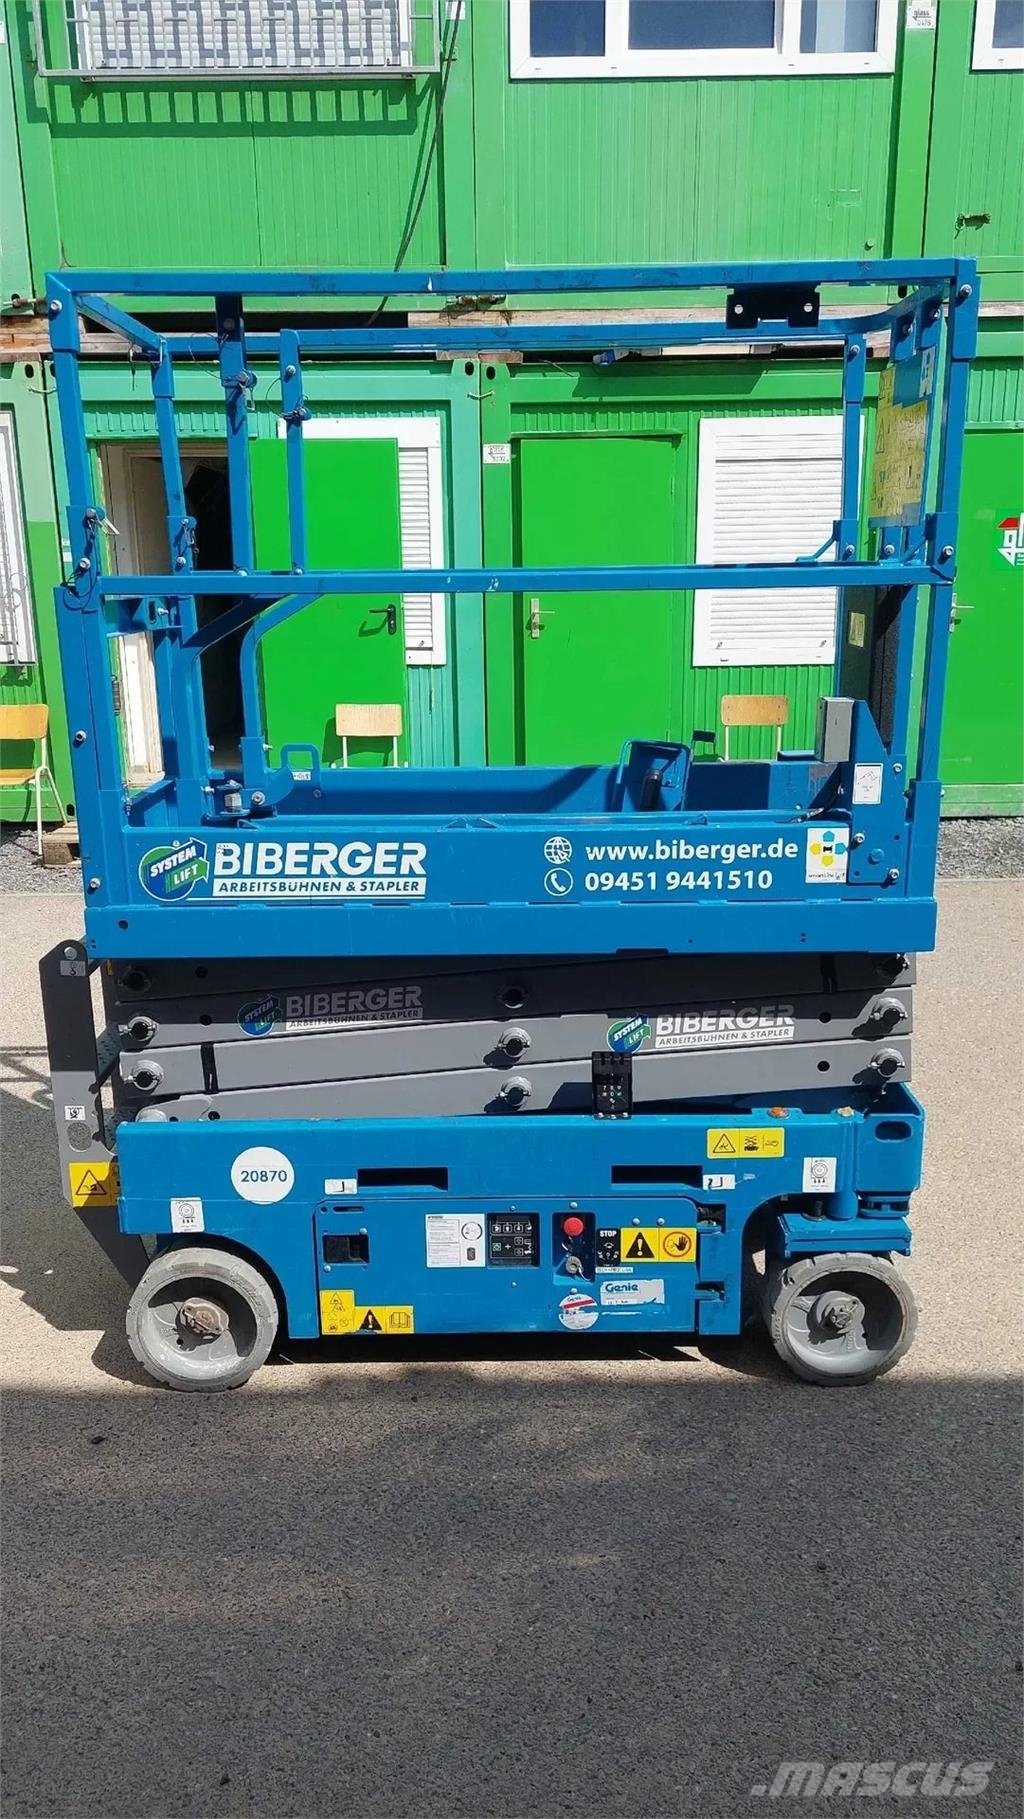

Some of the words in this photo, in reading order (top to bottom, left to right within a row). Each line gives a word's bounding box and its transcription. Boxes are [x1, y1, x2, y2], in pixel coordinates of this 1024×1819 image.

[150, 845, 197, 877] SYSTEM
[213, 842, 427, 876] BIBERGER
[585, 838, 798, 865] www.biberger.de
[173, 863, 199, 885] LIFT
[585, 871, 658, 891] 09451
[666, 870, 773, 890] 9441510
[218, 881, 341, 893] ARBEITSBÜHNEN
[345, 881, 357, 892] &
[359, 881, 420, 892] STAPLER
[244, 999, 275, 1022] SYSTEM
[286, 986, 422, 1018] BIBERGER
[380, 1010, 420, 1021] STAPLER
[656, 1004, 795, 1036] BIBERGER
[614, 1017, 643, 1042] SYSTEM
[628, 1028, 645, 1044] LIFT
[750, 1028, 790, 1039] STAPLER
[240, 1170, 288, 1183] 20870
[599, 1230, 617, 1238] STOP
[605, 1283, 639, 1293] Genie
